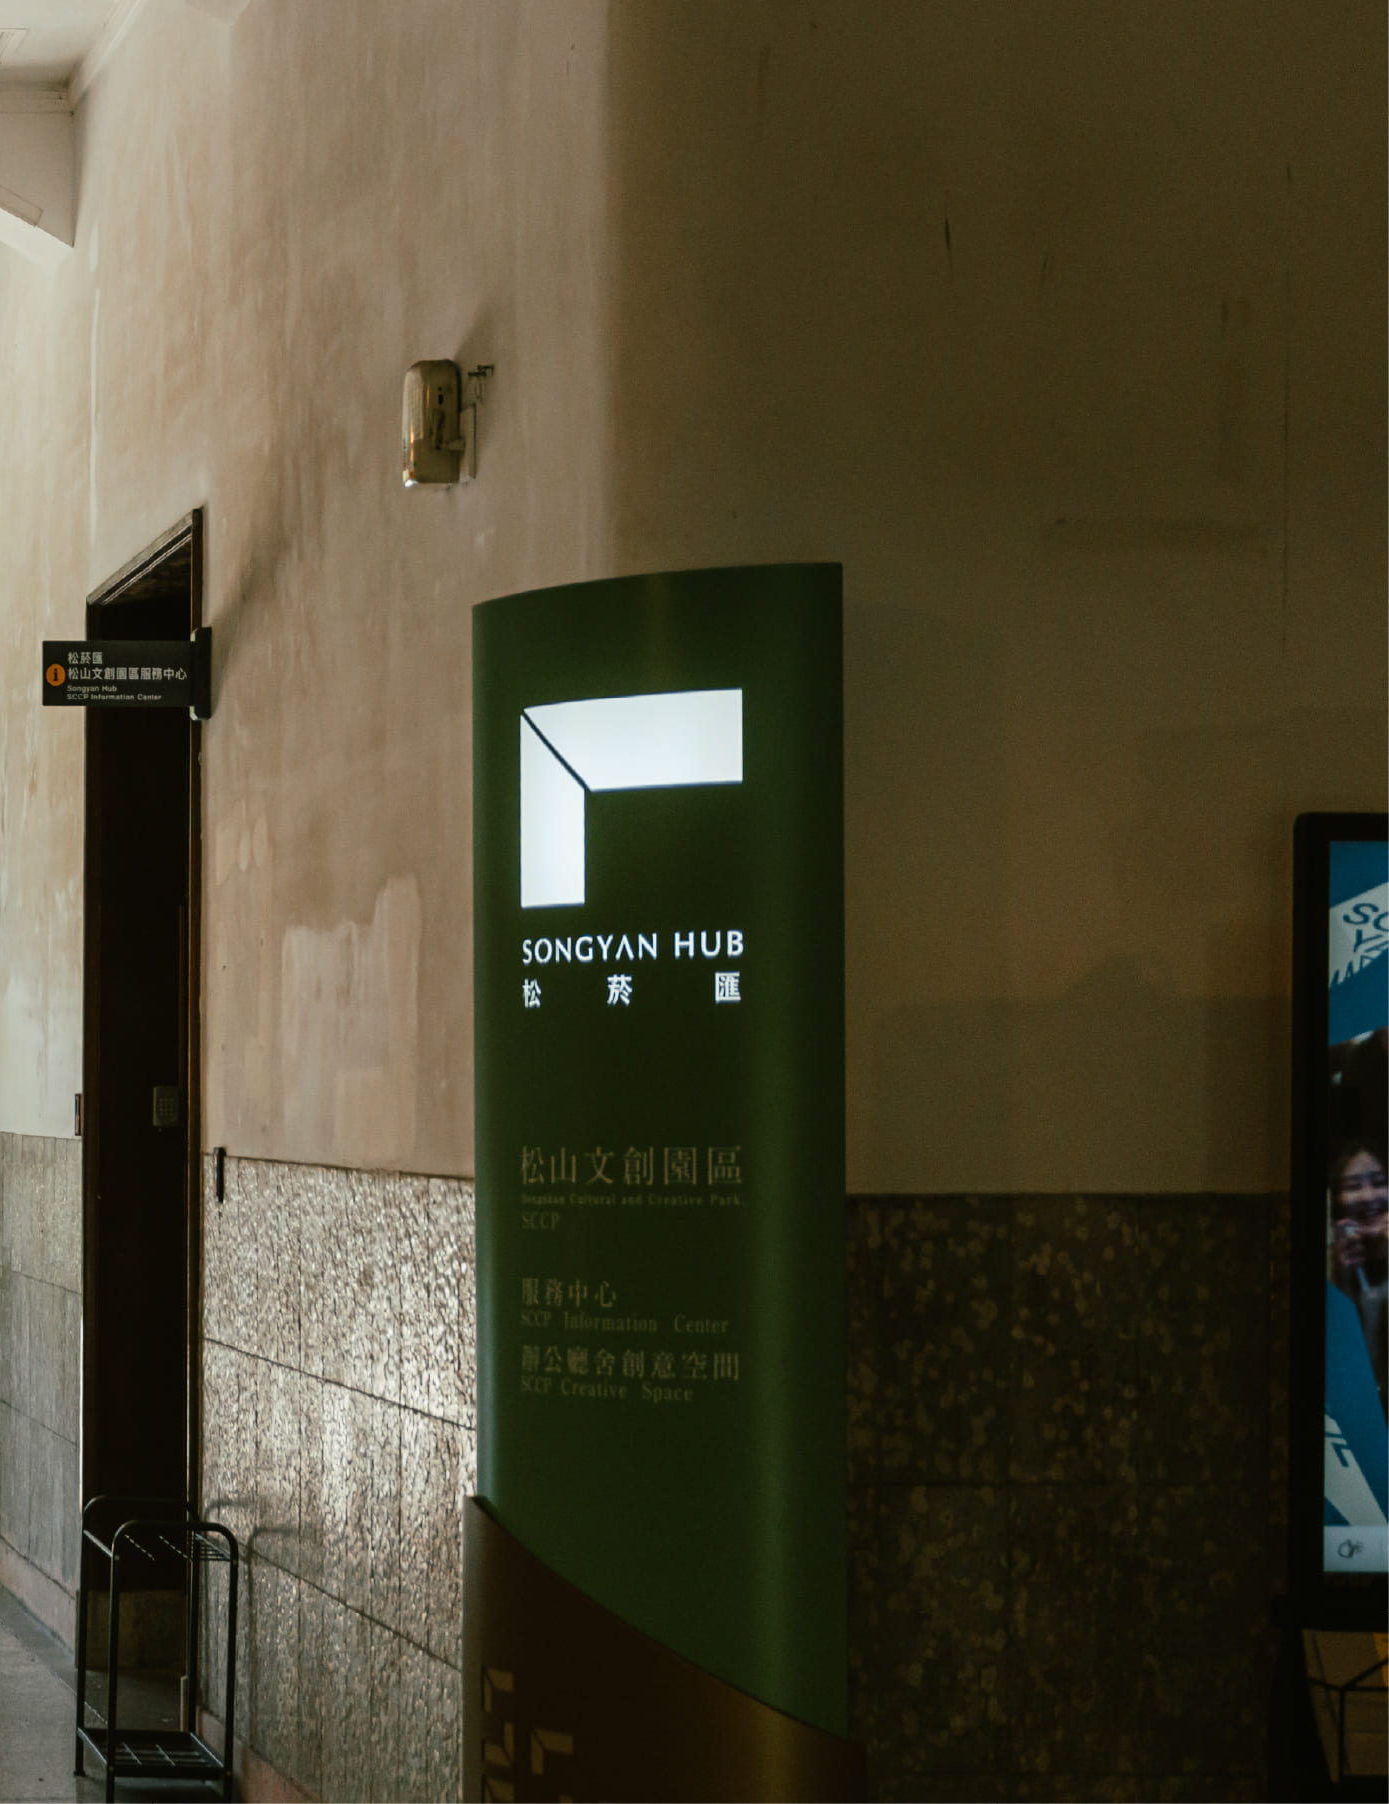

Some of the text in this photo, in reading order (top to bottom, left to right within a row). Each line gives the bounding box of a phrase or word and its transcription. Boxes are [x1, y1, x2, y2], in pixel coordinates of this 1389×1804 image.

[68, 652, 103, 664] 松菸匯
[68, 667, 187, 680] 松山文創園區服務中心
[67, 685, 99, 693] Songyan
[522, 930, 744, 965] SONGYAN HUB
[520, 1145, 742, 1187] 松山文創園區
[570, 1193, 616, 1205] Cultural
[621, 1194, 643, 1205] and
[648, 1194, 703, 1206] Creative
[521, 1212, 560, 1230] SCCP
[521, 1277, 617, 1309] 服務中心
[520, 1310, 729, 1335] SCCP Information Center
[520, 1375, 695, 1404] SCCP Creative Space
